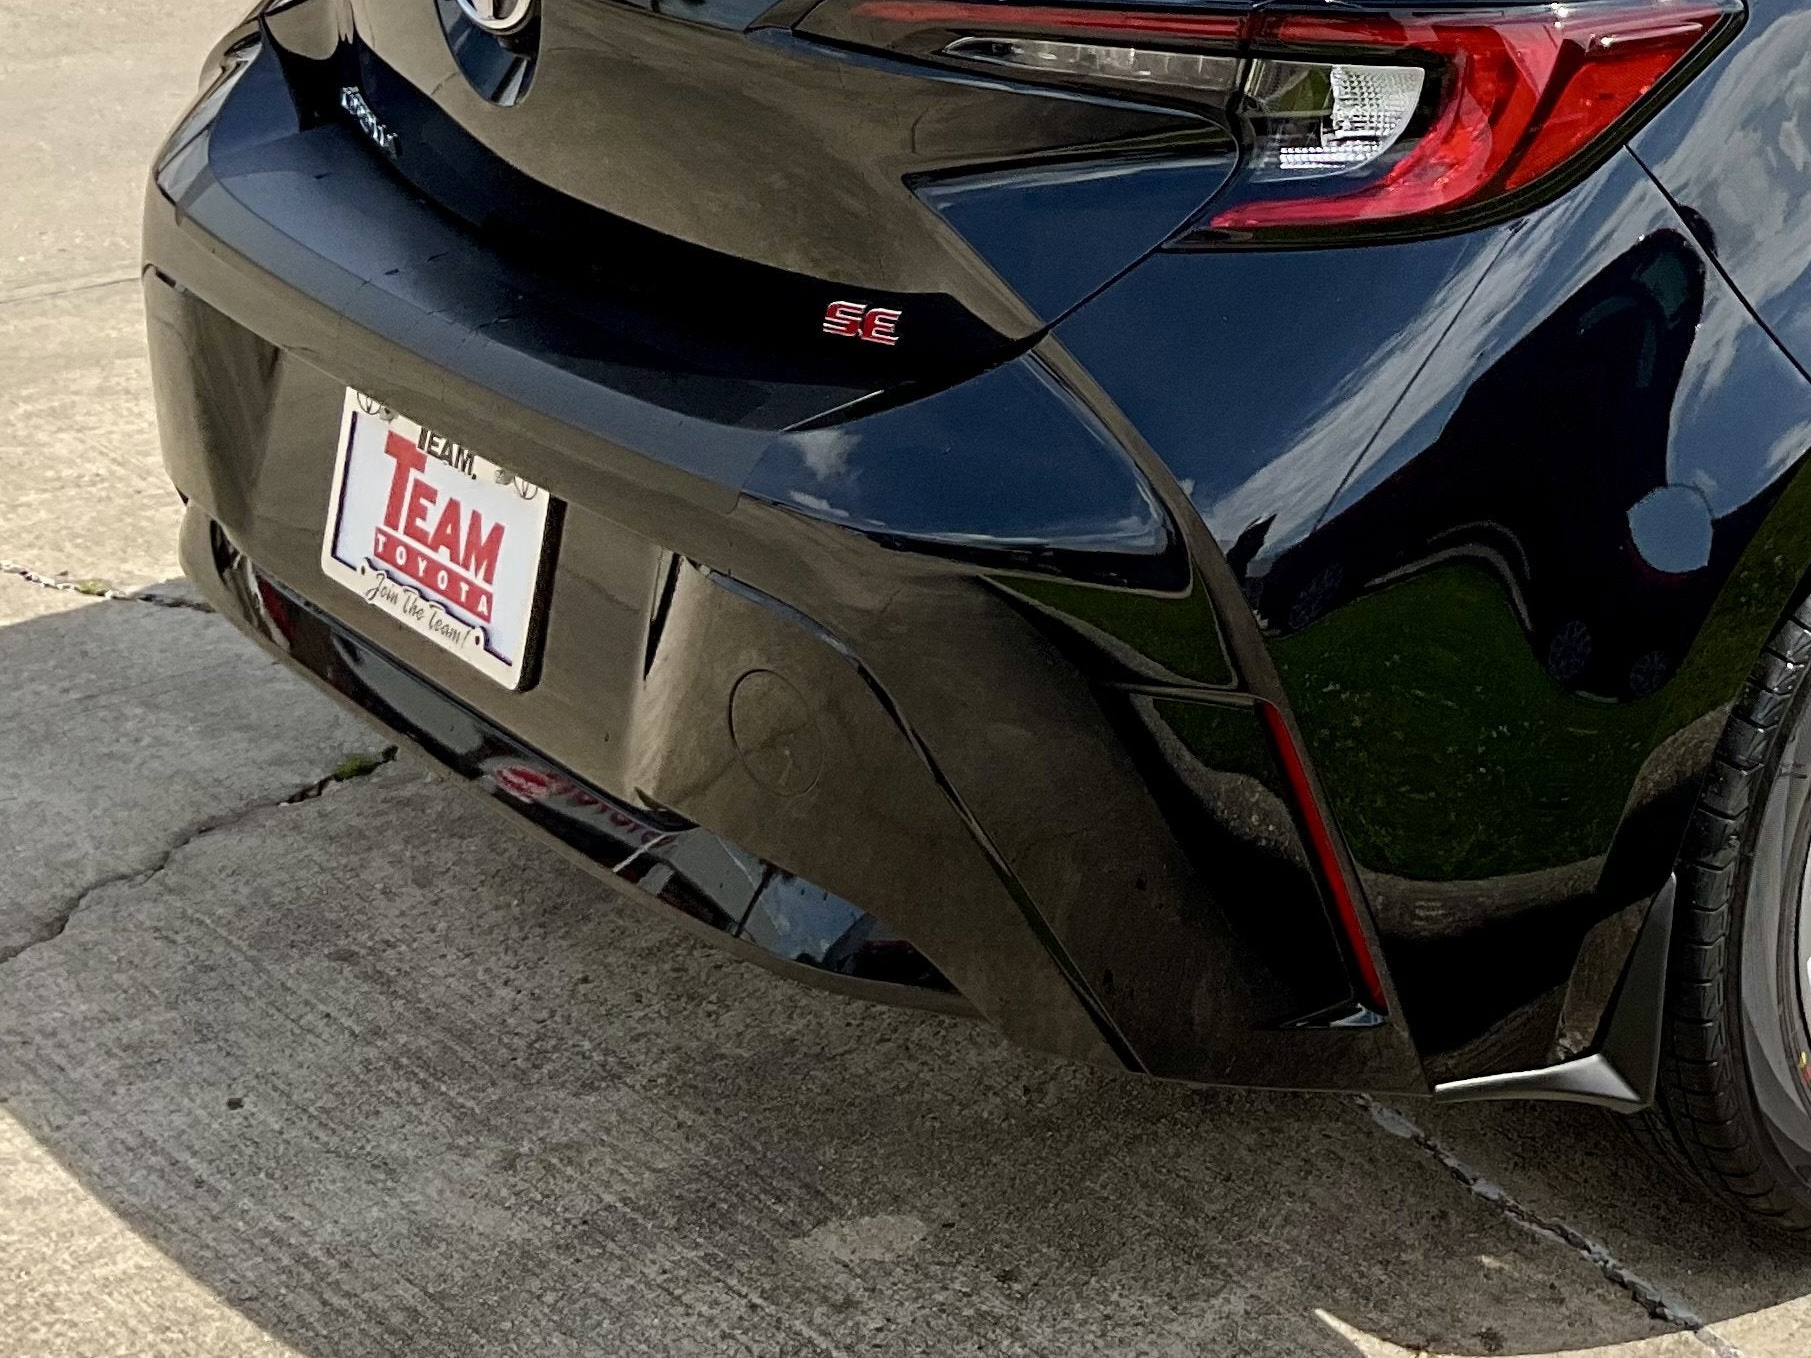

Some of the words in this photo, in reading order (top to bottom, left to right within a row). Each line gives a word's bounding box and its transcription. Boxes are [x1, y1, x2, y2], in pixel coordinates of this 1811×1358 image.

[823, 300, 902, 345] SE
[384, 429, 506, 586] TEAM
[366, 572, 399, 605] Join
[402, 587, 425, 622] The
[428, 602, 472, 649] Team!
[375, 534, 489, 617] TOYOTA
